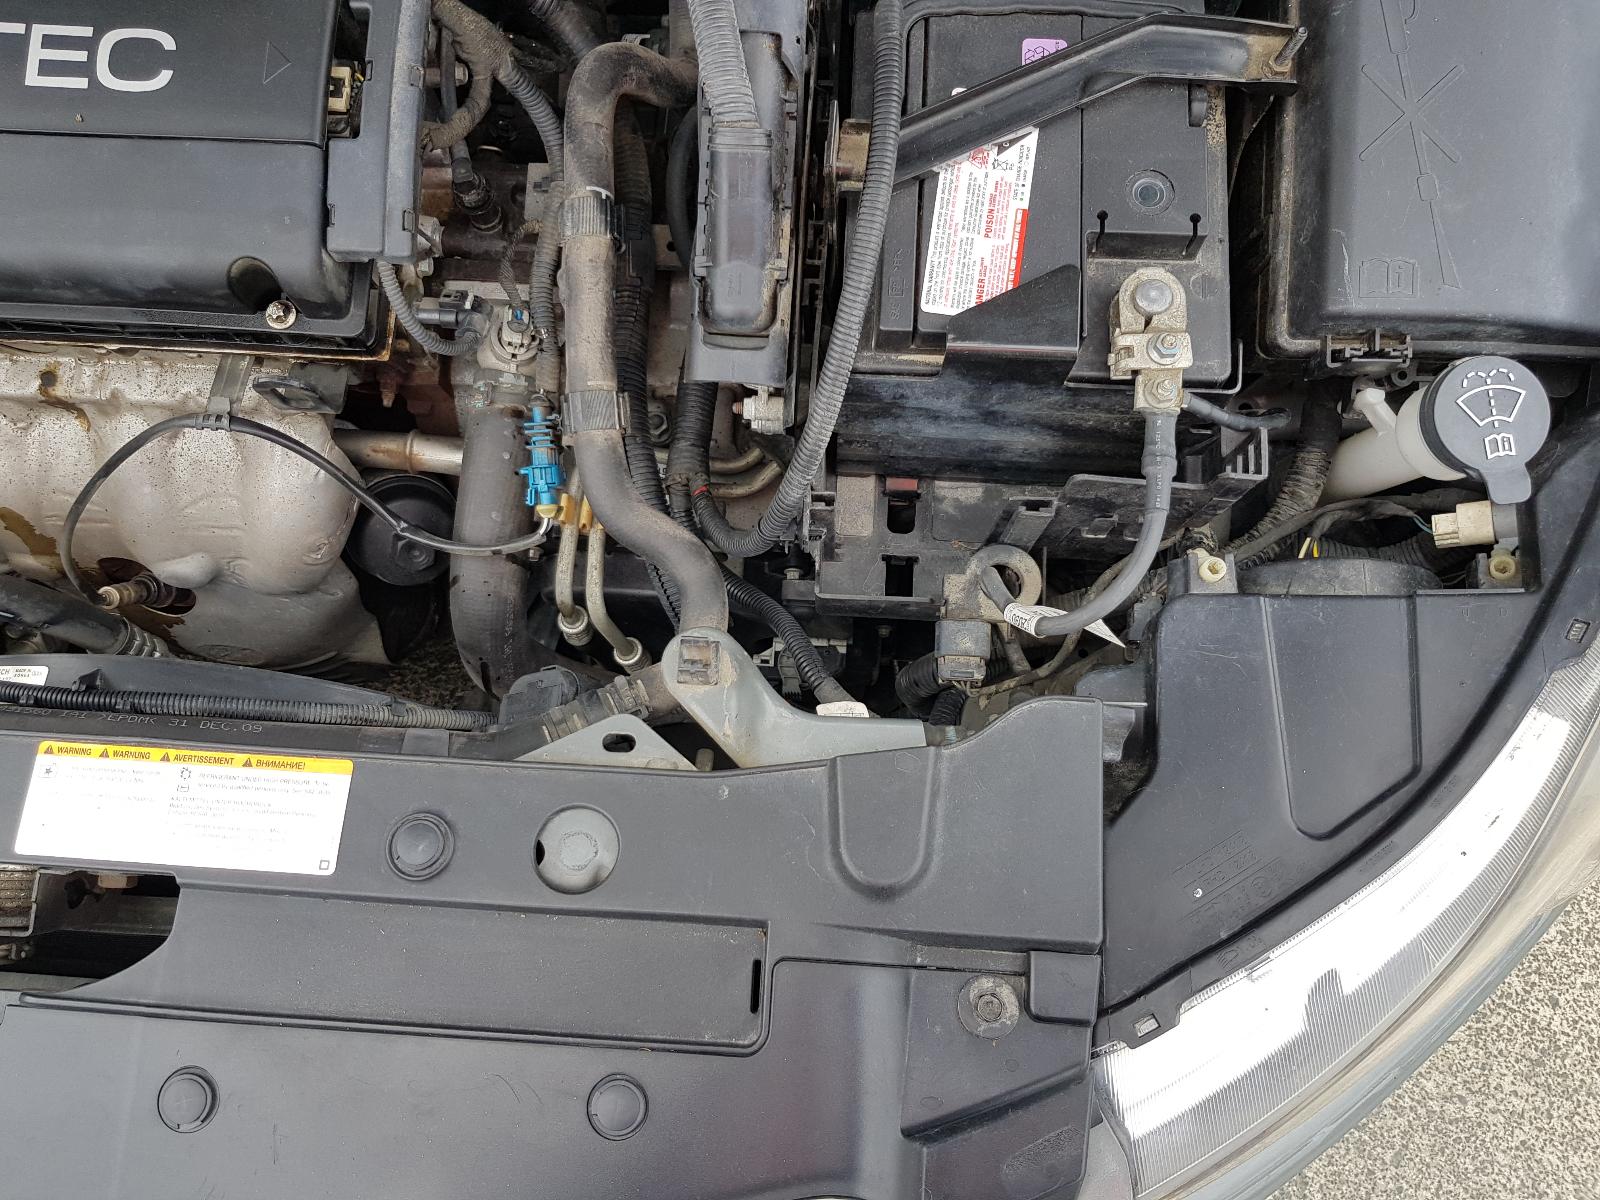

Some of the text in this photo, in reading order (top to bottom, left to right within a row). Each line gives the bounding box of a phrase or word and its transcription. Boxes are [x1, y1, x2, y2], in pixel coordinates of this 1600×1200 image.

[984, 208, 994, 238] POISON
[974, 278, 985, 306] ANGER
[57, 746, 234, 766] WARNING WARNUNG AVERTISSEMENT
[255, 759, 306, 770] ВНИМАНИЕ!
